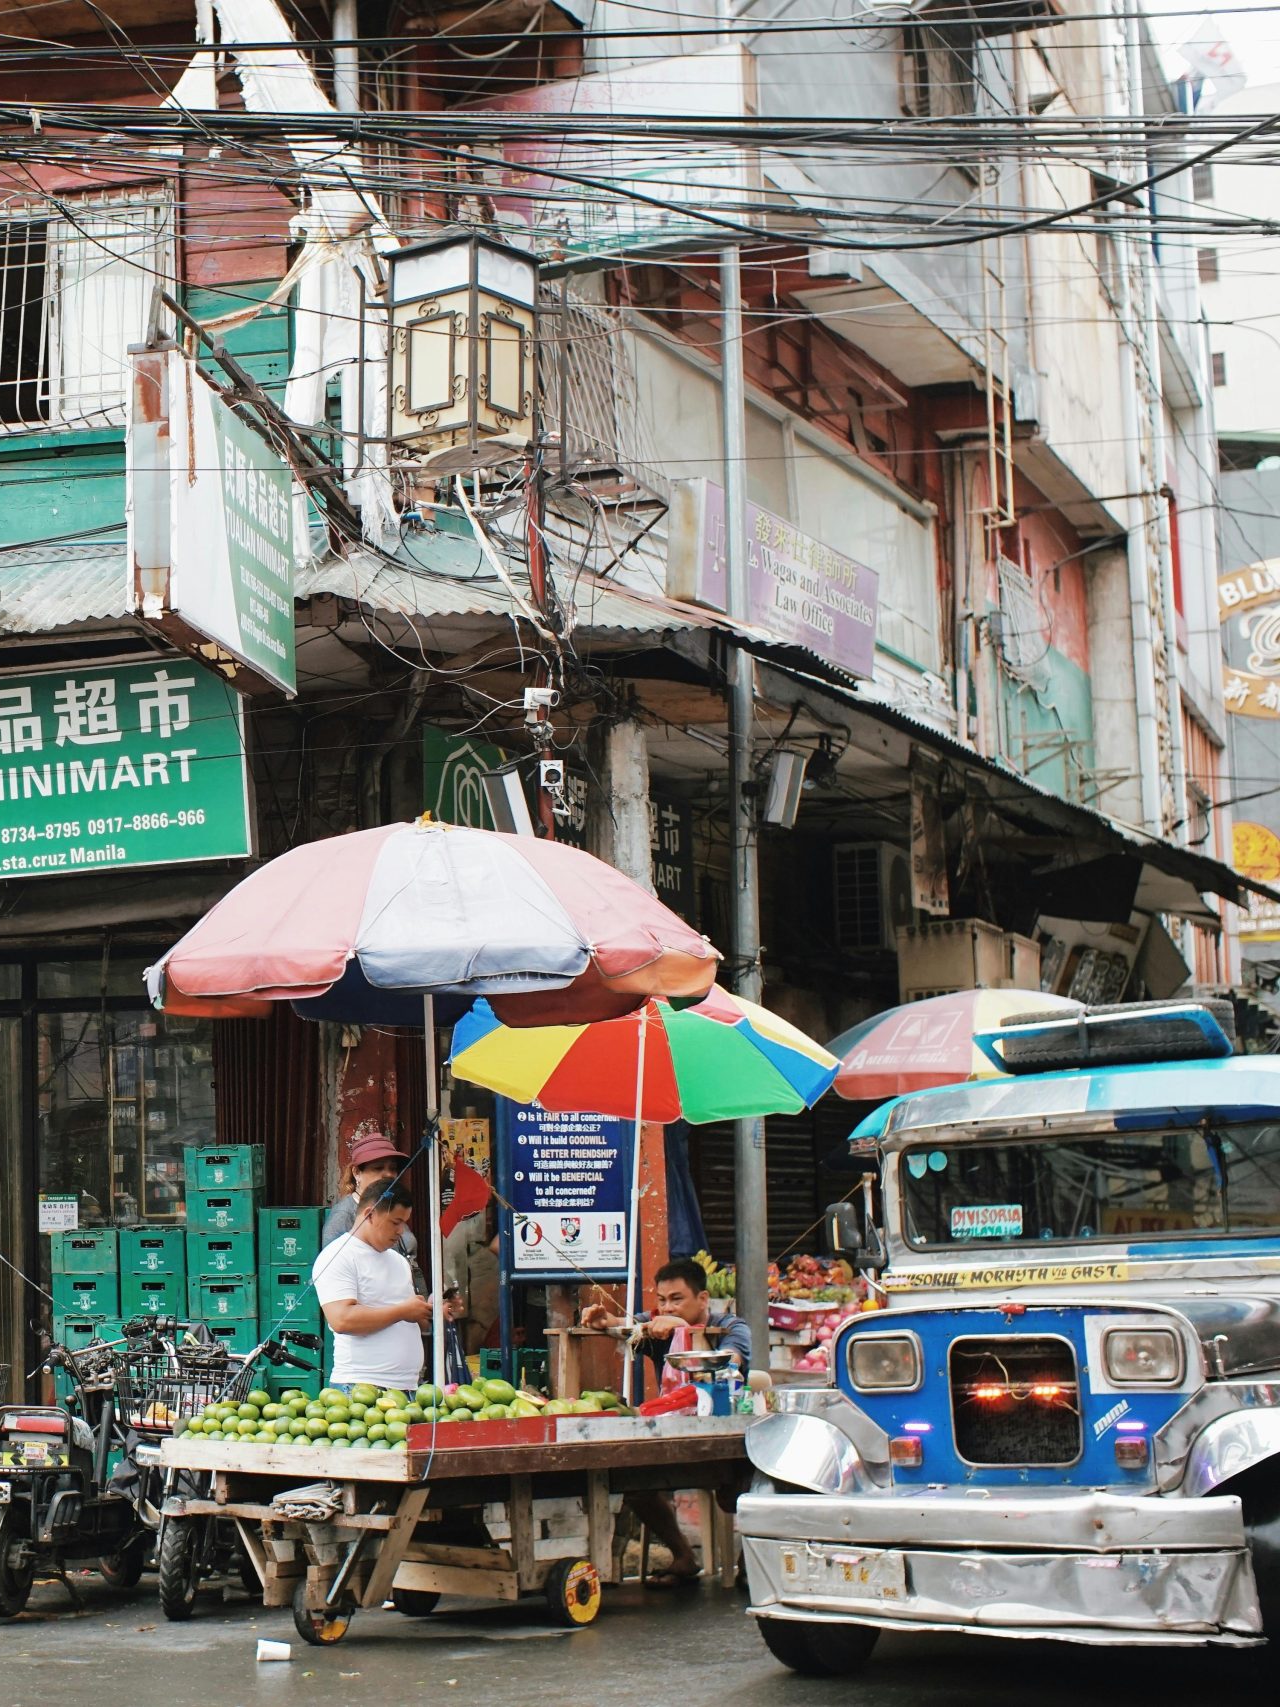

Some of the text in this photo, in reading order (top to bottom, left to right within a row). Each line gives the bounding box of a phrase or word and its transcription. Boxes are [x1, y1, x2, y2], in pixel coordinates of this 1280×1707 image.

[225, 505, 289, 585] TUALIAN MINIMART
[761, 545, 798, 585] Wagas
[800, 575, 820, 598] and
[822, 582, 873, 626] Associates
[775, 585, 798, 615] Law
[801, 600, 834, 635] Office
[1, 821, 81, 844] 8734-8795
[88, 809, 205, 836] 0917-8866-966
[70, 845, 126, 865] Manila
[536, 1112, 542, 1121] it
[543, 1112, 560, 1122] FAIR
[561, 1113, 569, 1122] to
[570, 1112, 579, 1121] all
[528, 1135, 542, 1145] Will
[543, 1135, 549, 1145] it
[550, 1135, 567, 1145] build
[569, 1135, 607, 1145] GOODWILL
[540, 1149, 569, 1159] BETTER
[570, 1149, 617, 1159] FRIENDSHIP?
[528, 1172, 543, 1182] Will
[543, 1172, 550, 1182] it
[551, 1172, 560, 1182] be
[561, 1172, 604, 1182] BENEFICIAL
[535, 1186, 596, 1195] to all concerned?
